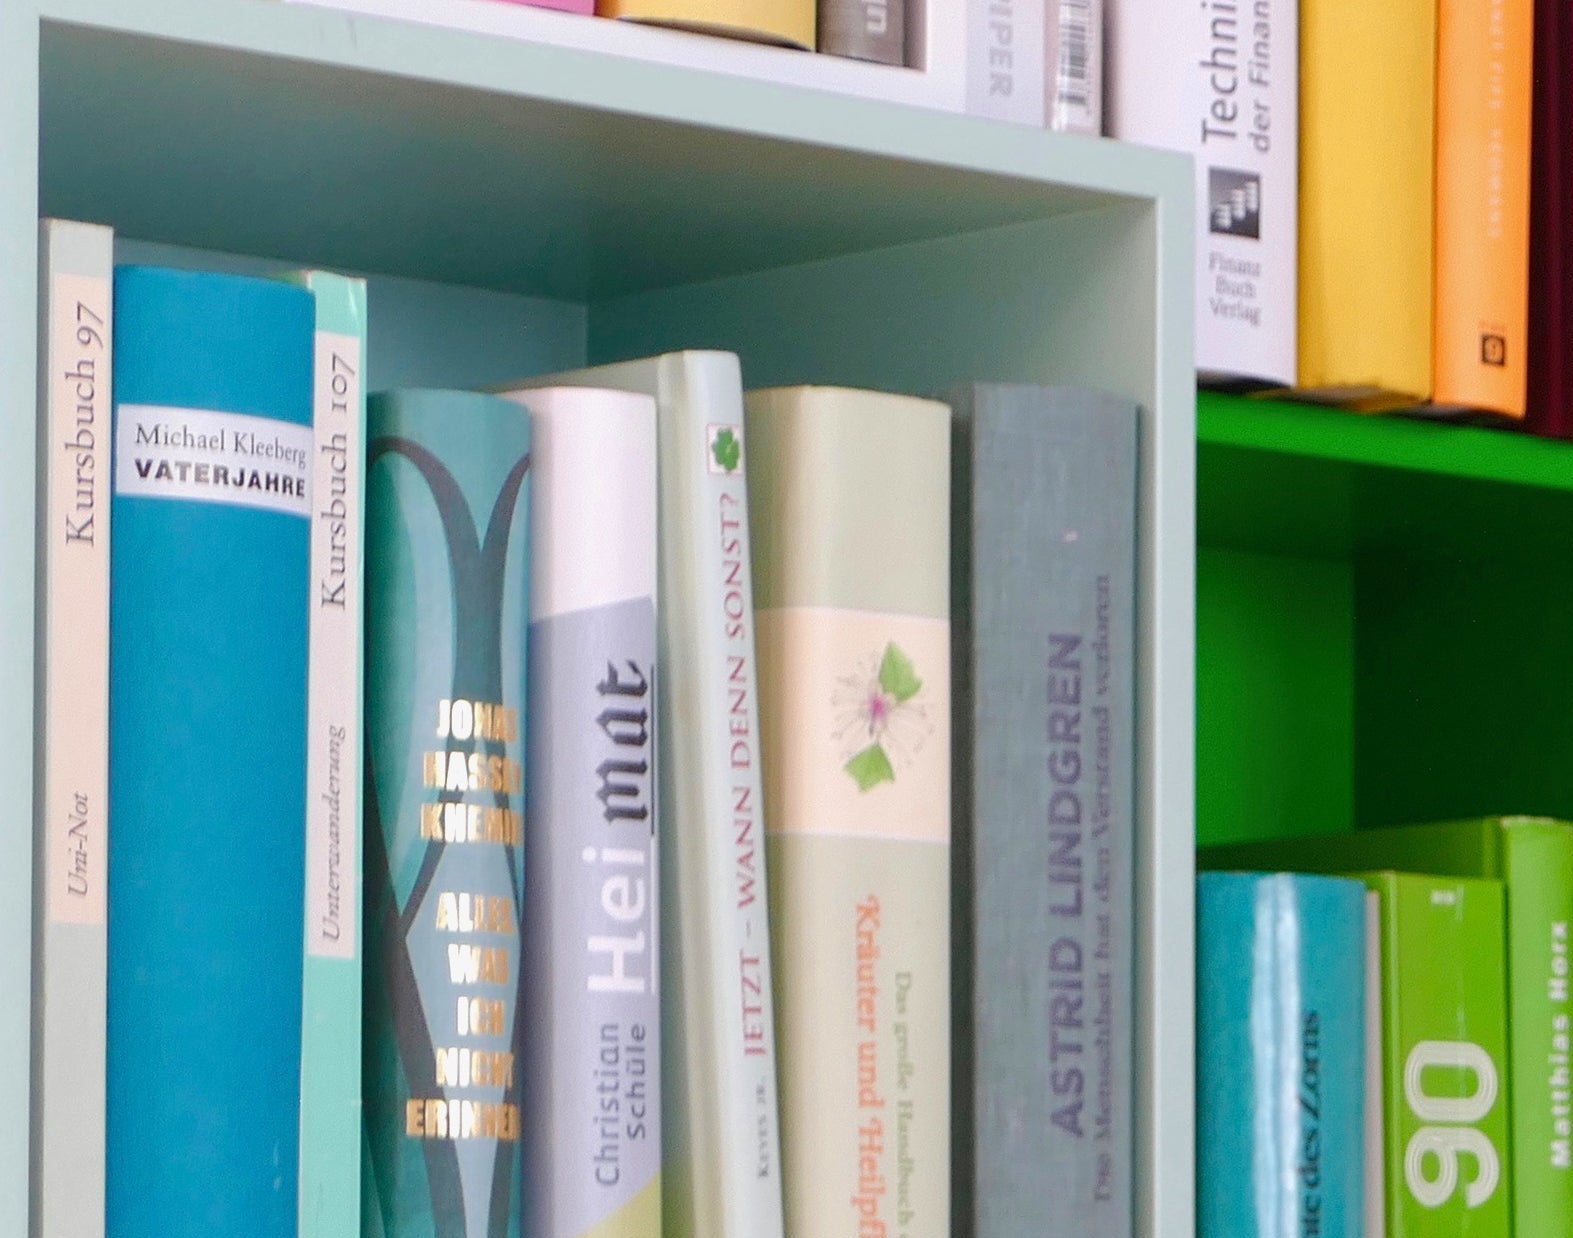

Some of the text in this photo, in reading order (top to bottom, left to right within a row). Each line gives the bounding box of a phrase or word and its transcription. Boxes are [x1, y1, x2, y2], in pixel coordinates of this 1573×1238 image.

[1248, 103, 1271, 153] der
[65, 300, 104, 547] Kursbuch 97
[134, 457, 306, 499] VATERJAHRE
[135, 422, 307, 469] Michael Kleeberg
[320, 352, 356, 611] Kursbuch 107
[321, 725, 346, 942] Unterwanderung
[719, 491, 767, 1056] JETZT WANN DENN SONST?
[67, 791, 89, 899] Uni-Not
[1046, 632, 1084, 1139] ASTRID LINDGREN
[456, 996, 505, 1036] ICH
[855, 892, 882, 1034] Kräuter
[894, 971, 914, 1016] Das
[594, 1021, 620, 1187] Christian
[625, 1021, 646, 1141] Schüle
[855, 1040, 885, 1109] und
[1548, 920, 1572, 1169] Matthias Horx
[894, 1101, 914, 1226] Handbuch
[1403, 1039, 1500, 1209] 90
